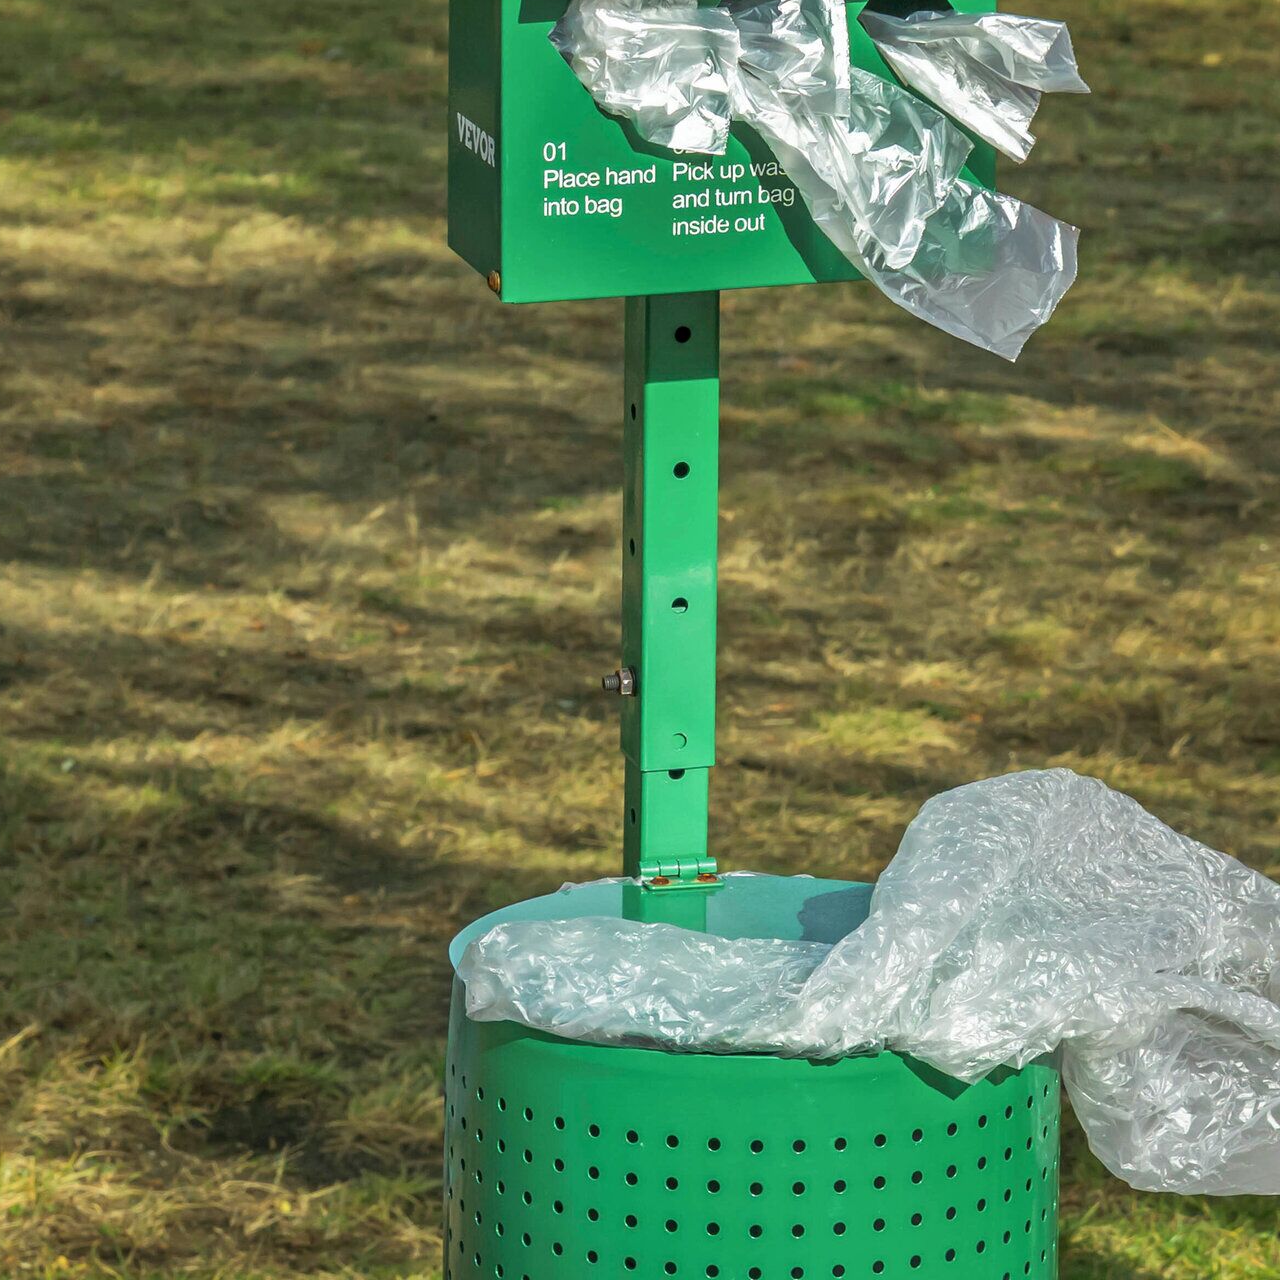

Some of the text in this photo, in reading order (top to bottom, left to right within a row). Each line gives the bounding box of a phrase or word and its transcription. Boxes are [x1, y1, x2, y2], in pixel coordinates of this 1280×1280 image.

[456, 111, 496, 168] VEVOR
[542, 141, 567, 162] 01
[543, 164, 657, 189] Place hand
[672, 161, 715, 182] Pick
[719, 163, 745, 183] up
[543, 195, 624, 218] into bag
[672, 184, 795, 209] and turn bag
[672, 213, 766, 236] inside out
